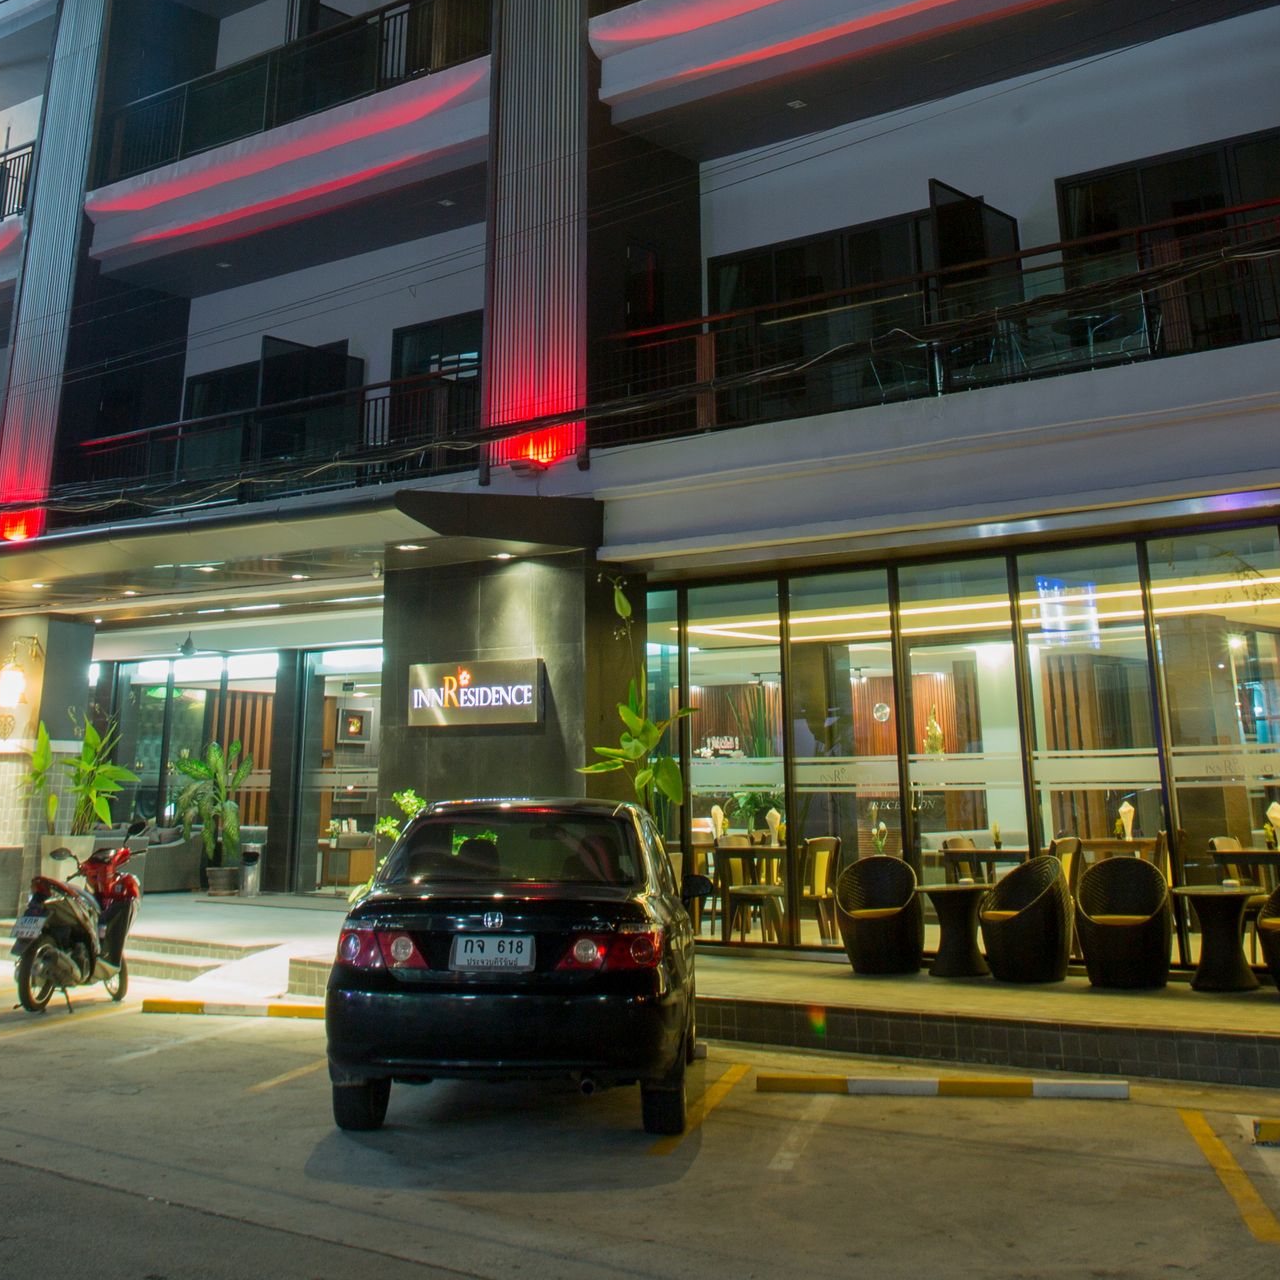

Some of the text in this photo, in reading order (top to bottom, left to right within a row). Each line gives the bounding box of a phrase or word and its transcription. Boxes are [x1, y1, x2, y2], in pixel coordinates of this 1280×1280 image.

[871, 799, 936, 811] RECEON
[464, 939, 524, 955] กจ 618
